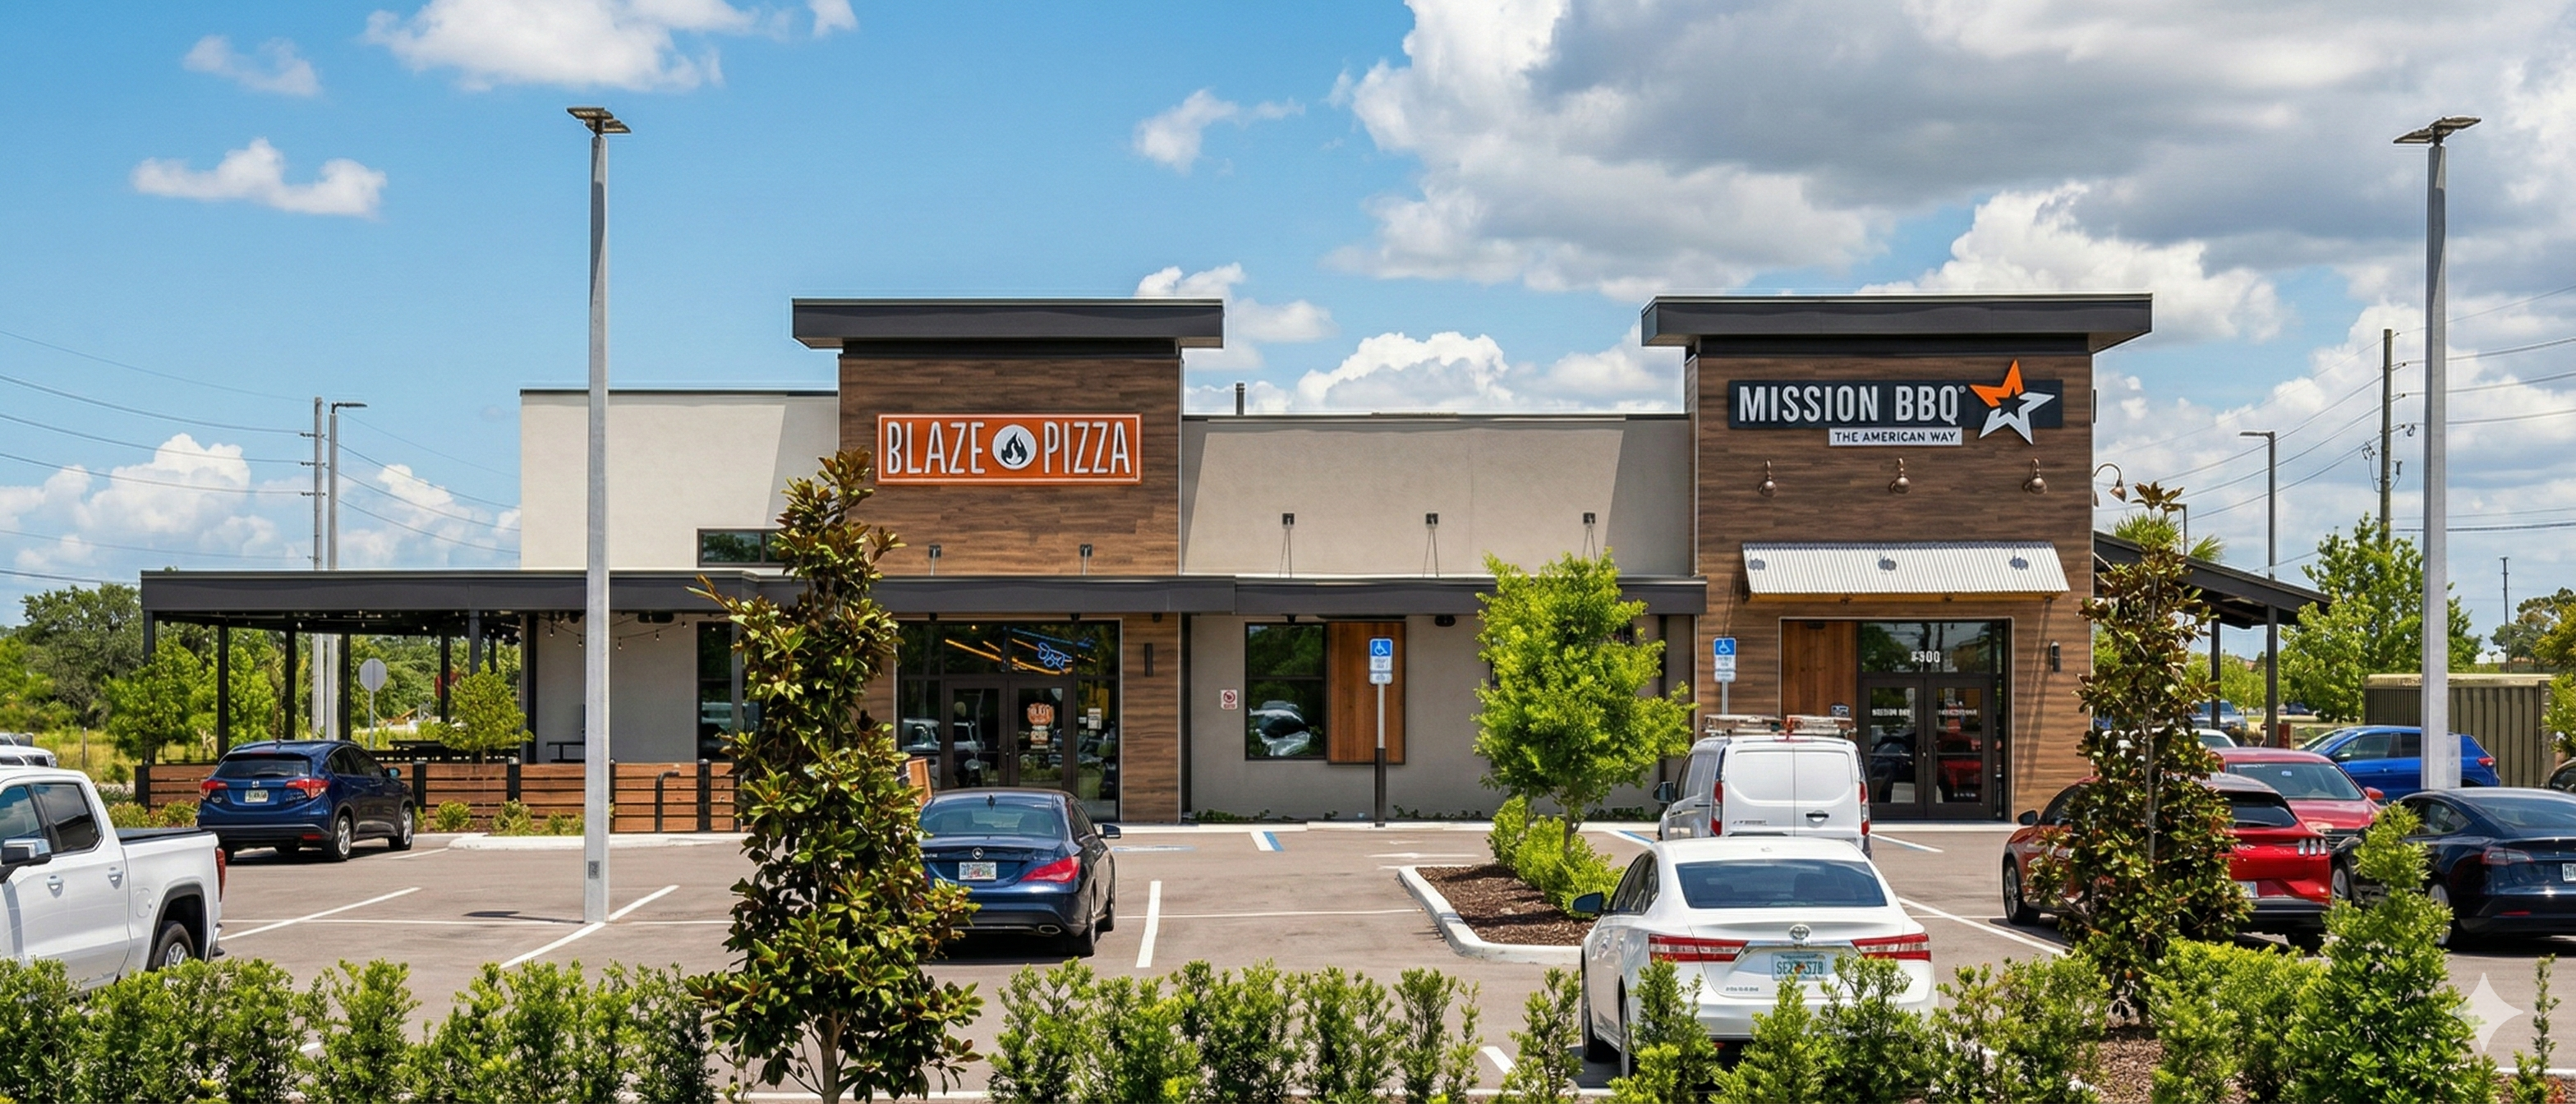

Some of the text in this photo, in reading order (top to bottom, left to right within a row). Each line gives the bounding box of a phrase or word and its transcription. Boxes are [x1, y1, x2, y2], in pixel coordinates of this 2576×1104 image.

[1739, 384, 1958, 426] MISSION BBQ
[886, 421, 1131, 475] BLAZE PIZZA
[1834, 431, 1957, 442] THE AMERICAN WAY
